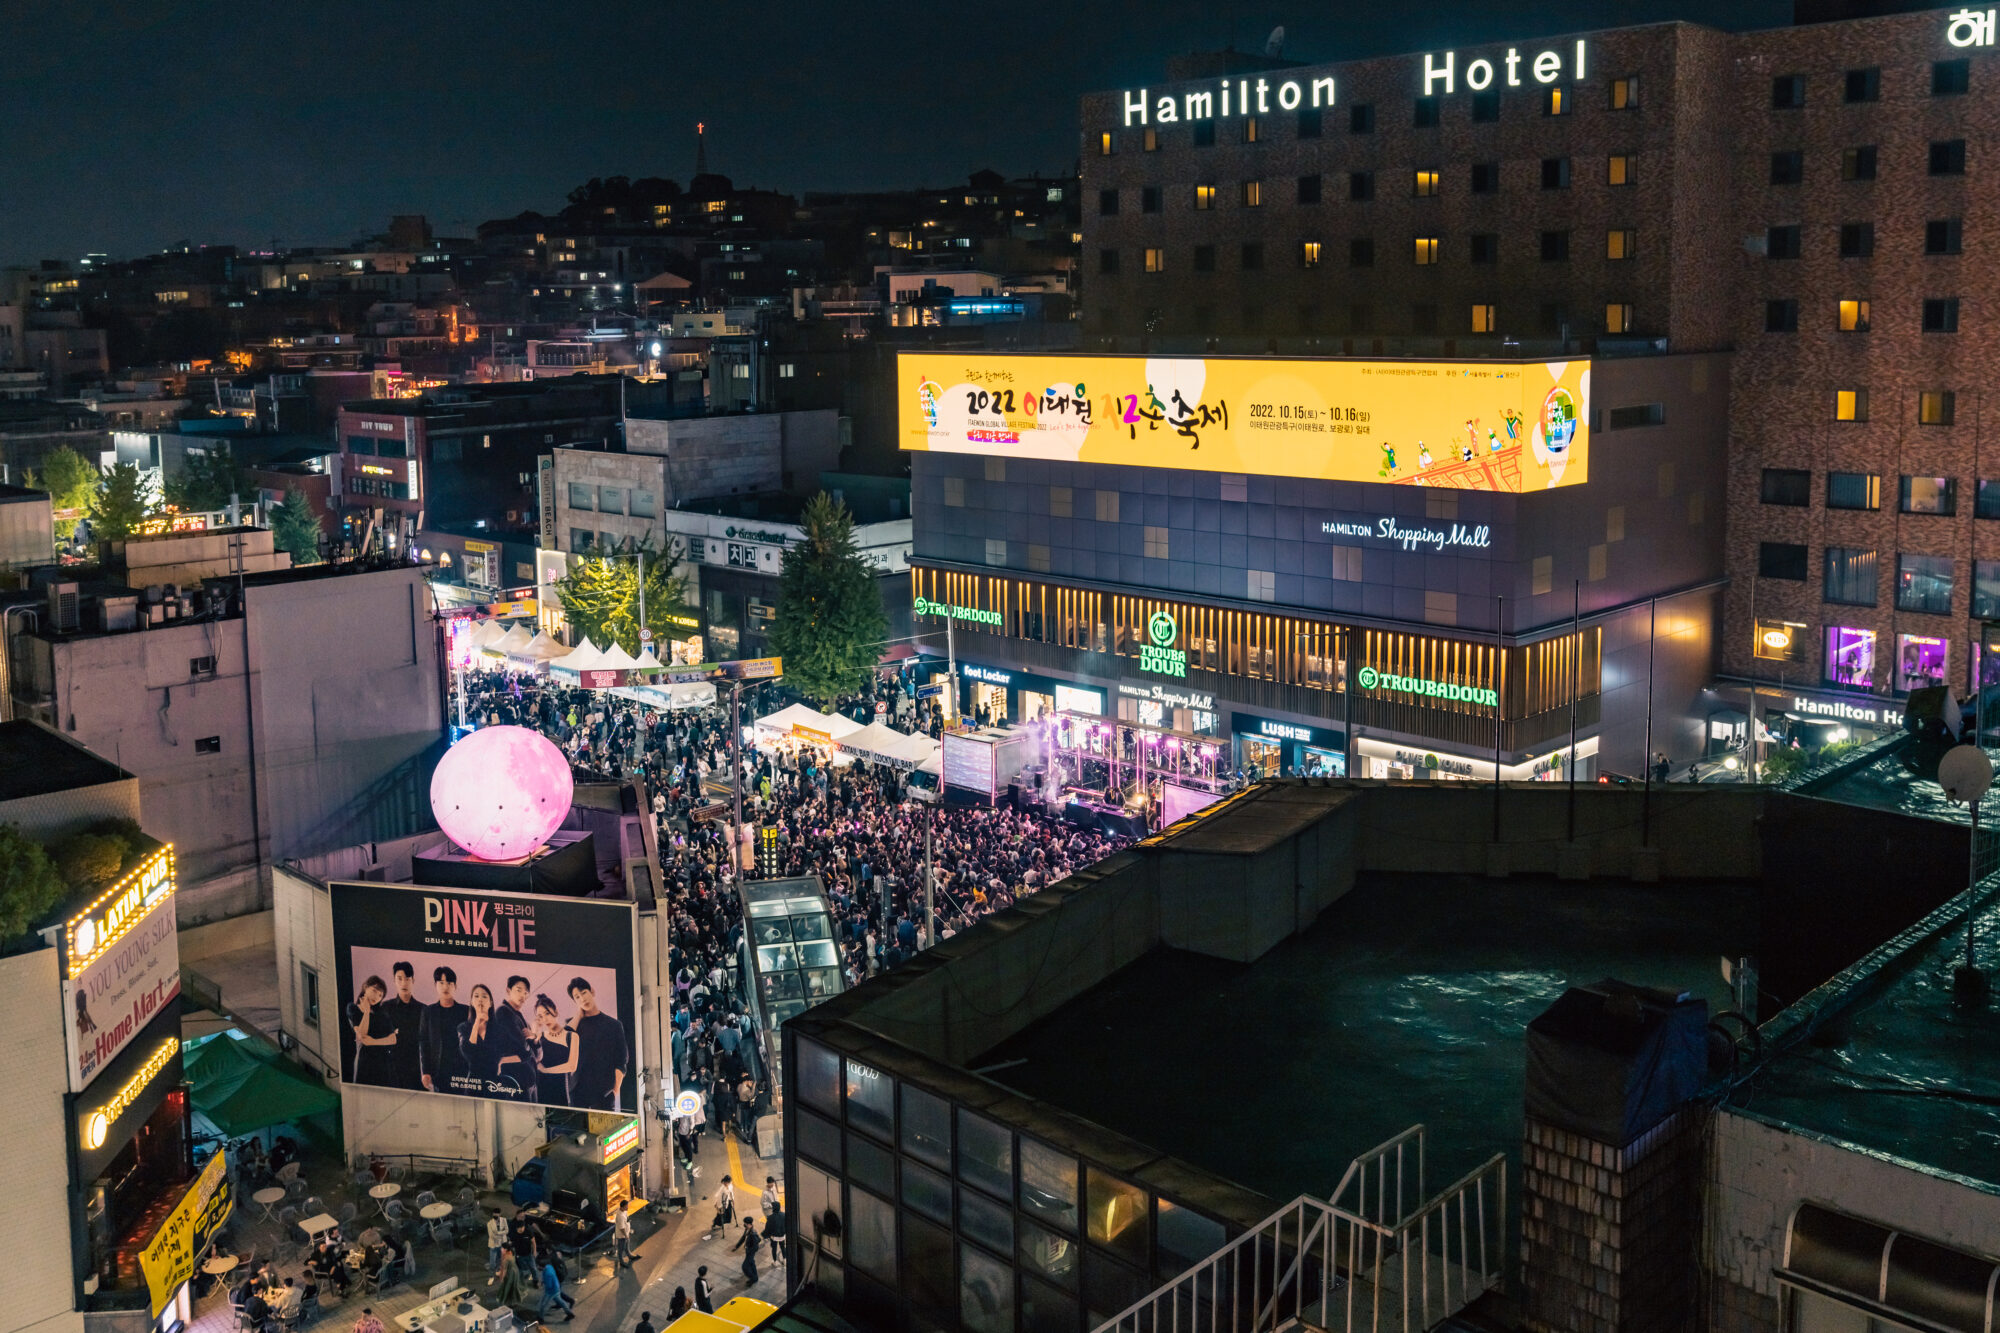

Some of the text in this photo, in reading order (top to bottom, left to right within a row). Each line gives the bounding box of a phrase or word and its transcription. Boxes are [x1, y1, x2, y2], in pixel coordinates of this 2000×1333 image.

[1947, 8, 1996, 48] 해
[1124, 40, 1586, 126] Hamilton Hotel
[966, 389, 1016, 415] 2022
[1023, 383, 1093, 425] 이태원
[1018, 421, 1036, 429] FESTIVAL
[1037, 423, 1047, 431] 2022
[1356, 425, 1370, 435] 일대
[543, 473, 553, 536] NORTH BEACH
[1322, 517, 1491, 551] HAMILTON Shopping Mall
[489, 556, 497, 581] 부동산
[1140, 644, 1186, 663] TROUBA
[983, 667, 1010, 684] Locker
[1140, 656, 1186, 678] DOUR
[1118, 684, 1213, 710] HAMILTON Shopping Mall
[1379, 673, 1498, 707] TROUBADOUR
[1794, 697, 1876, 722] Hamilton
[1261, 721, 1295, 739] LUSH
[874, 753, 913, 770] COCKTAIL BAR
[1396, 750, 1424, 767] OLIVE
[96, 882, 141, 946] LATIN
[140, 855, 169, 898] PUB
[493, 902, 535, 917] 핑크라이
[424, 897, 490, 938] PINK
[490, 918, 537, 954] LIE
[88, 910, 175, 1002] YOU YOUNG SILK
[95, 978, 165, 1066] Home Mart
[81, 1059, 97, 1080] OPEN
